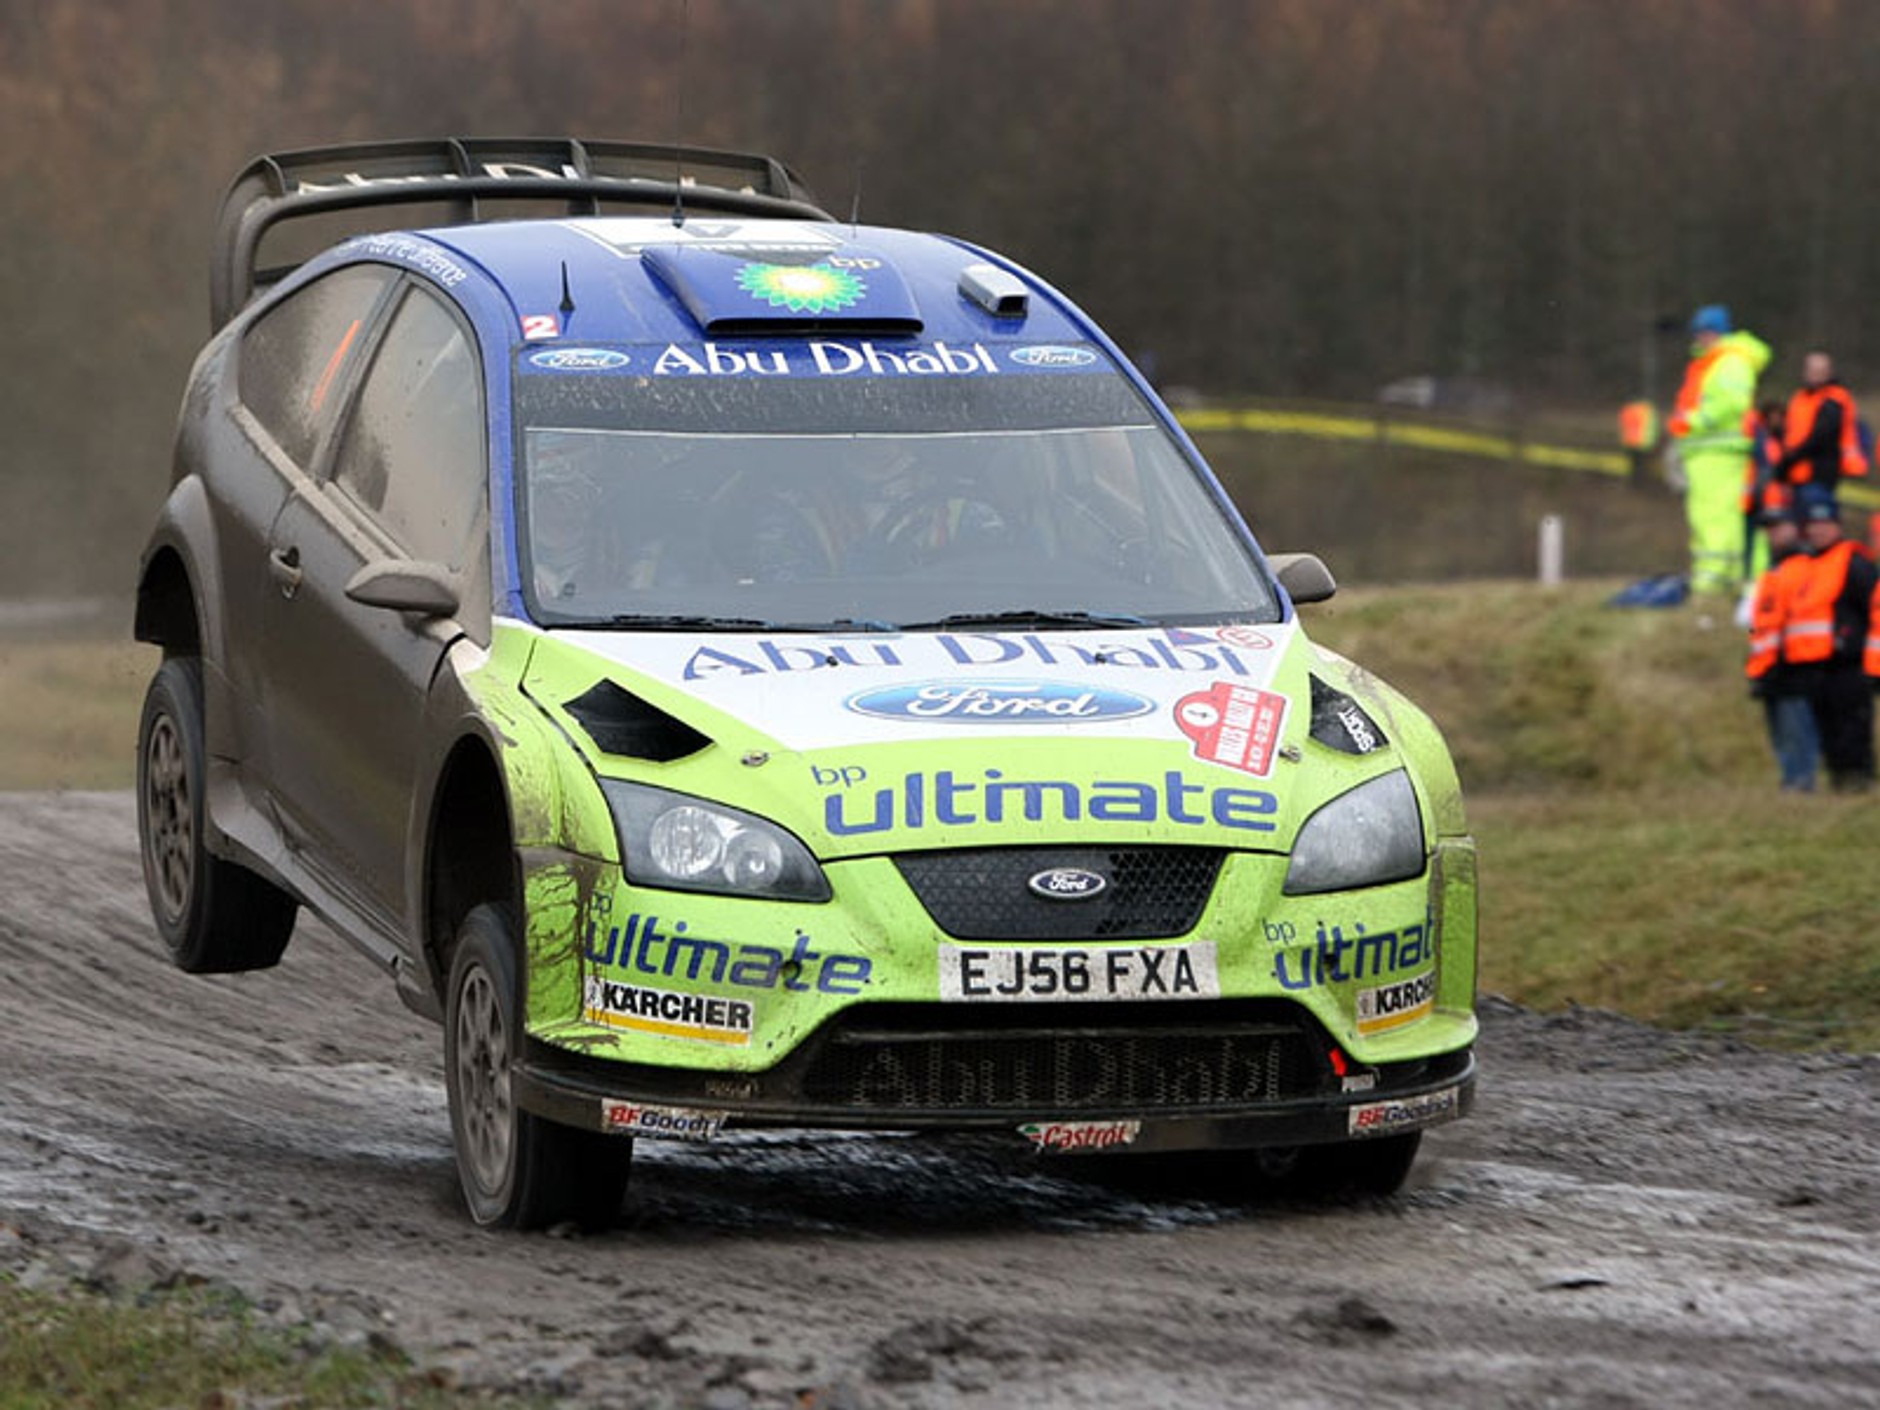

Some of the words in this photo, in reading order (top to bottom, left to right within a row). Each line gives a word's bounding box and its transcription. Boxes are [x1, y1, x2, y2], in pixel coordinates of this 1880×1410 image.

[830, 255, 881, 270] bp
[653, 342, 790, 375] Abu
[683, 640, 902, 681] Abu
[936, 634, 1249, 676] Dhabi
[906, 683, 1101, 717] Ford
[810, 764, 867, 788] bp
[824, 768, 1278, 836] ultimate
[1048, 871, 1090, 891] Ford
[1262, 917, 1296, 945] bp
[585, 914, 873, 995] ultimate
[960, 949, 1090, 996] EJ56
[1107, 948, 1199, 994] FXA
[602, 981, 751, 1030] KÄRCHER
[852, 1040, 1030, 1106] Abu
